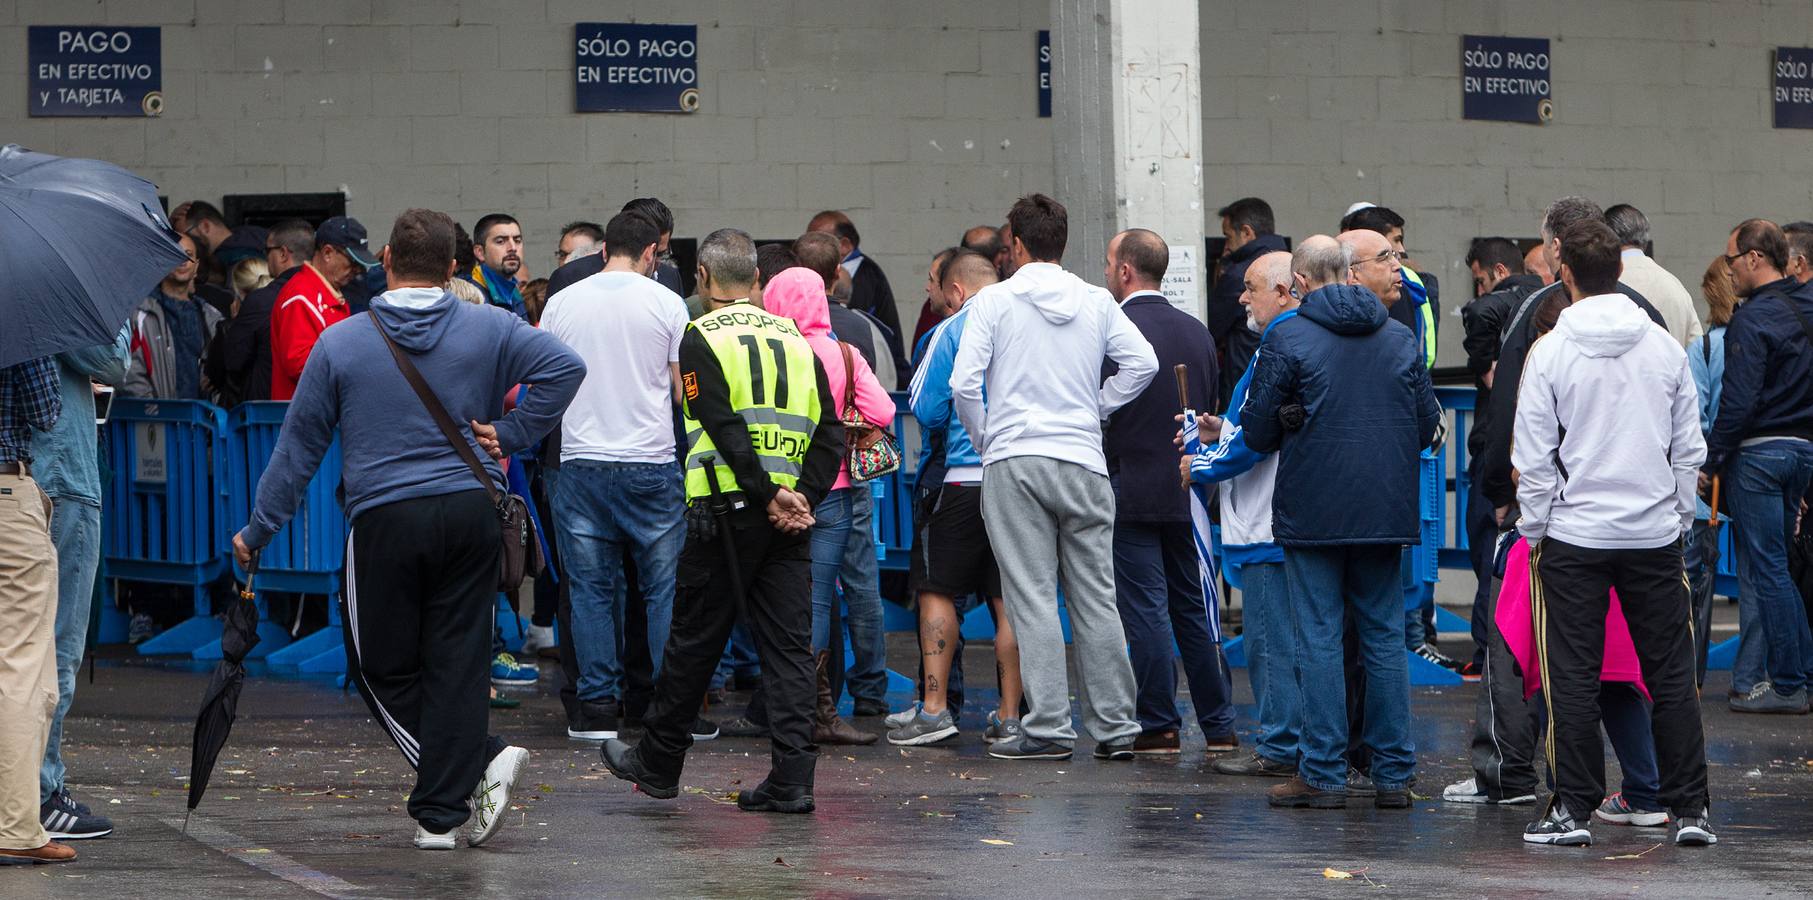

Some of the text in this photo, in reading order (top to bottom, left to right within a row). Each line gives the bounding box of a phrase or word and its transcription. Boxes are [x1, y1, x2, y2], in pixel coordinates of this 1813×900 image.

[59, 31, 132, 53] PAGO
[577, 31, 696, 57] SÓLO PAGO
[1040, 45, 1050, 63] S
[1464, 43, 1549, 70] SÓLO PAGO
[39, 63, 152, 80] EN EFECTIVO
[577, 65, 696, 84] EN EFECTIVO
[1776, 54, 1808, 79] SÓLO
[1040, 72, 1049, 88] E
[1464, 76, 1550, 95] EN EFECTIVO
[57, 87, 125, 108] TARJETA
[1776, 86, 1813, 103] EN EFE
[737, 334, 789, 410] 11
